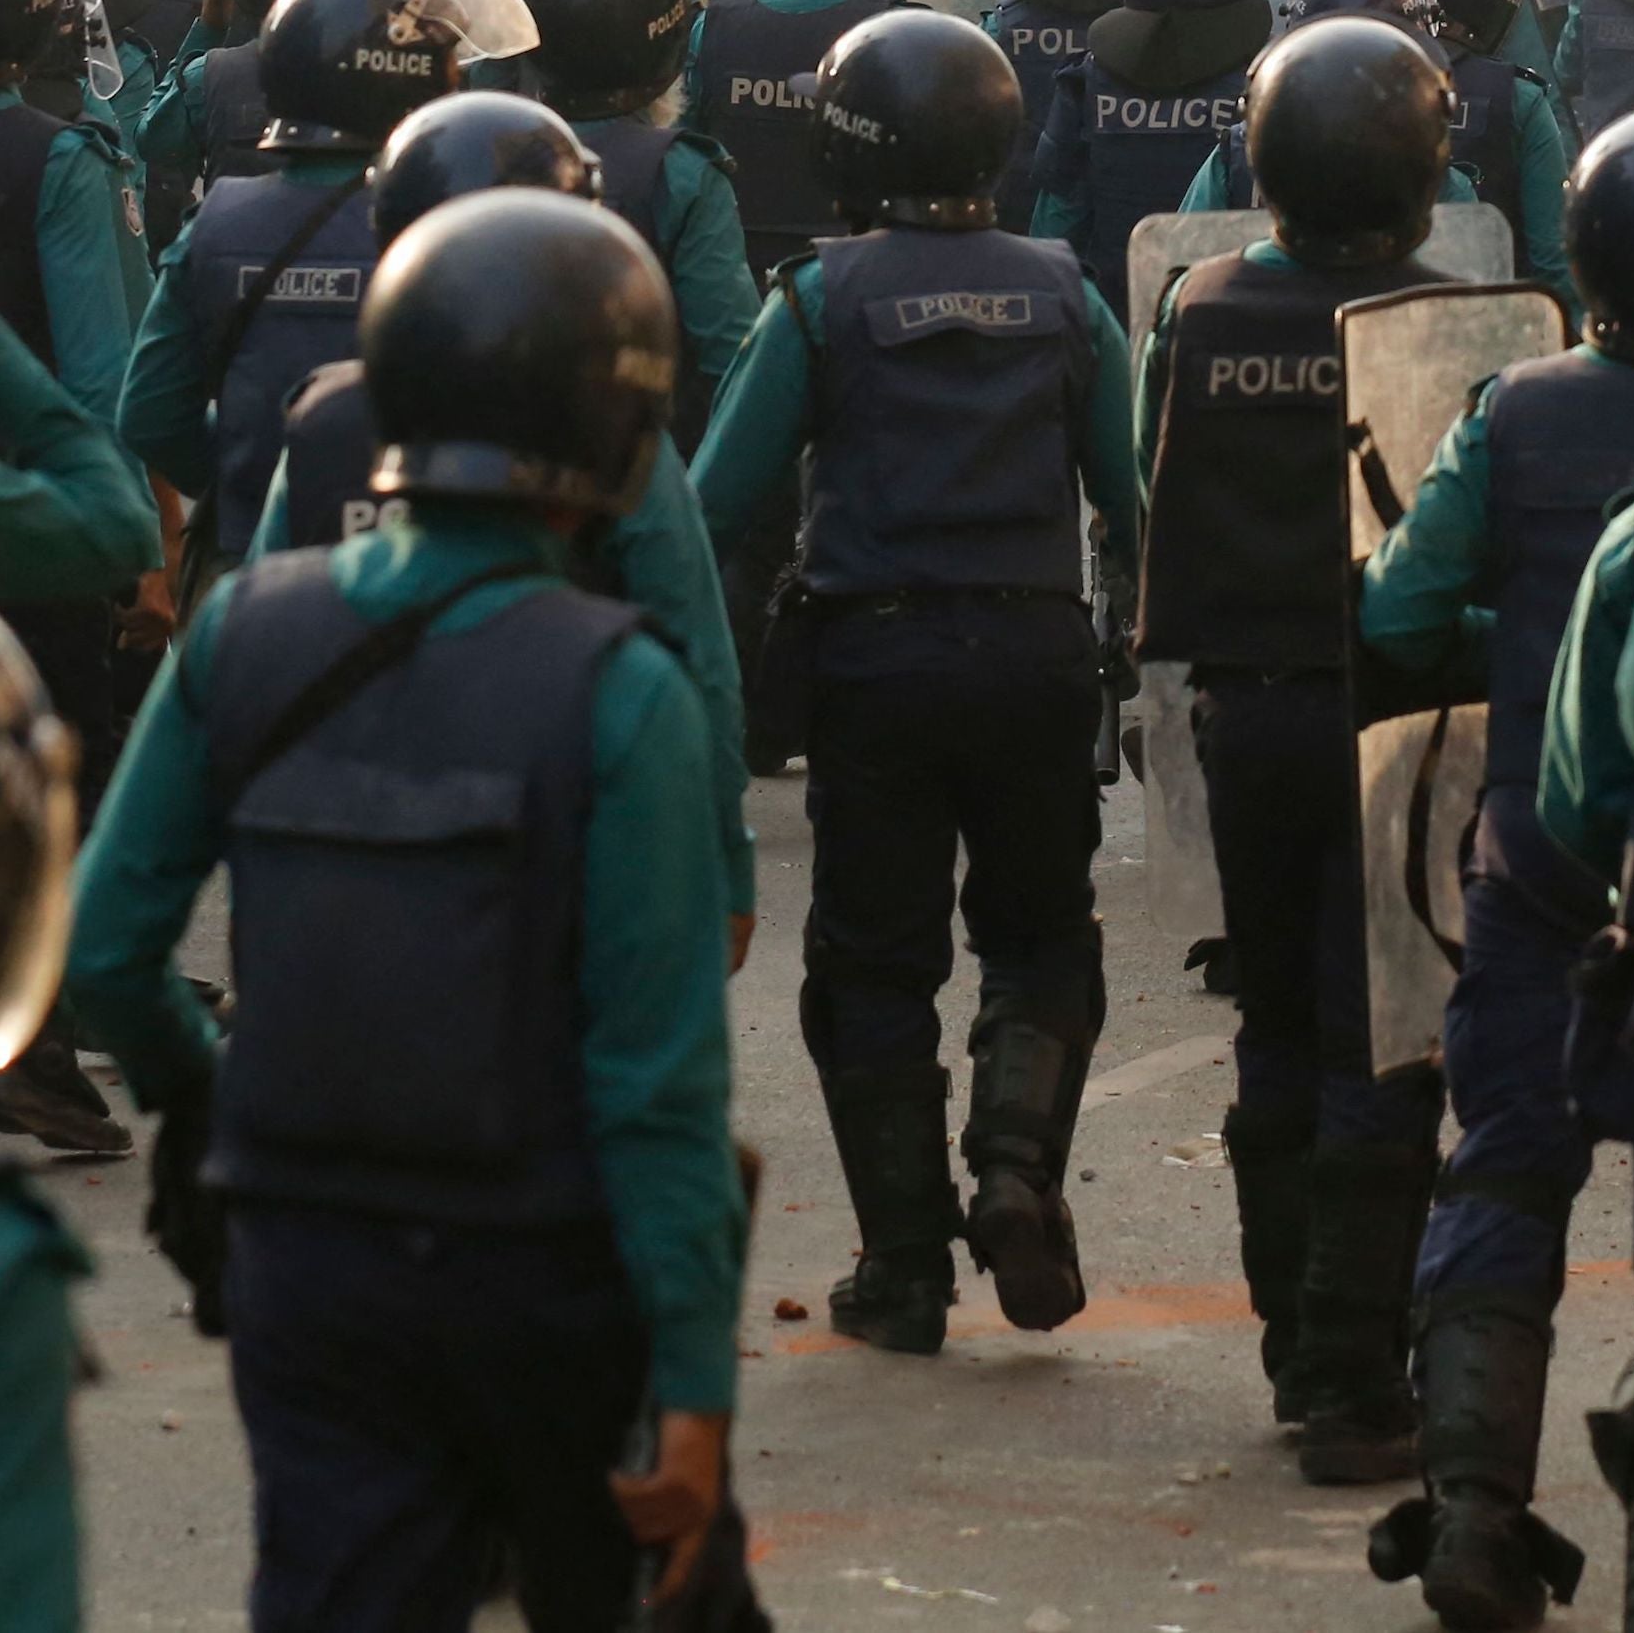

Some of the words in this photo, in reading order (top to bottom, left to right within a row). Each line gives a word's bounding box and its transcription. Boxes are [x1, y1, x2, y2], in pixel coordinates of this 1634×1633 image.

[648, 0, 686, 41] POLICE
[1012, 28, 1084, 58] POL
[354, 48, 433, 77] POLICE
[823, 100, 883, 145] POLICE
[1096, 94, 1236, 131] POLICE
[274, 268, 342, 297] OLICE
[920, 295, 1009, 322] POLICE
[1209, 354, 1341, 398] POLIC
